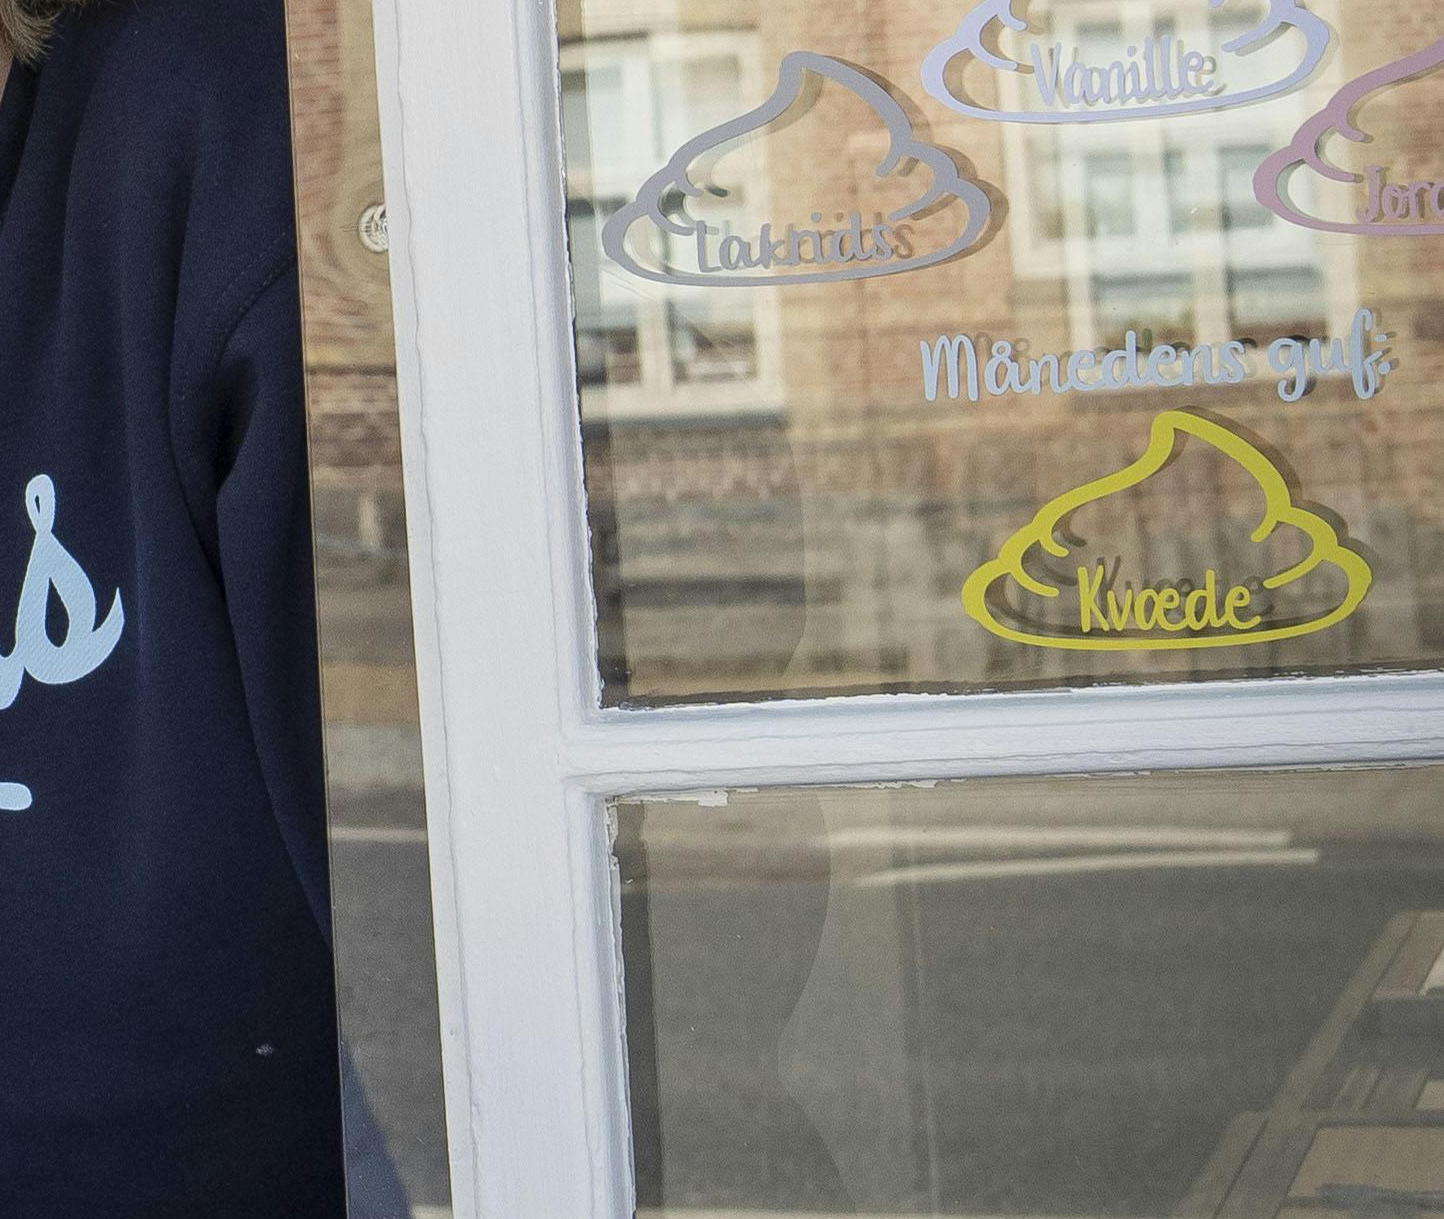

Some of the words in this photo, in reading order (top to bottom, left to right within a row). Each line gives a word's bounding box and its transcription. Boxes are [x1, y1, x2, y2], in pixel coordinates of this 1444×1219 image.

[1031, 34, 1214, 107] Vanille
[694, 211, 892, 273] Lakrids
[920, 330, 1248, 402] Månedens
[1267, 307, 1391, 402] guf:
[1078, 565, 1262, 632] Kvæde
